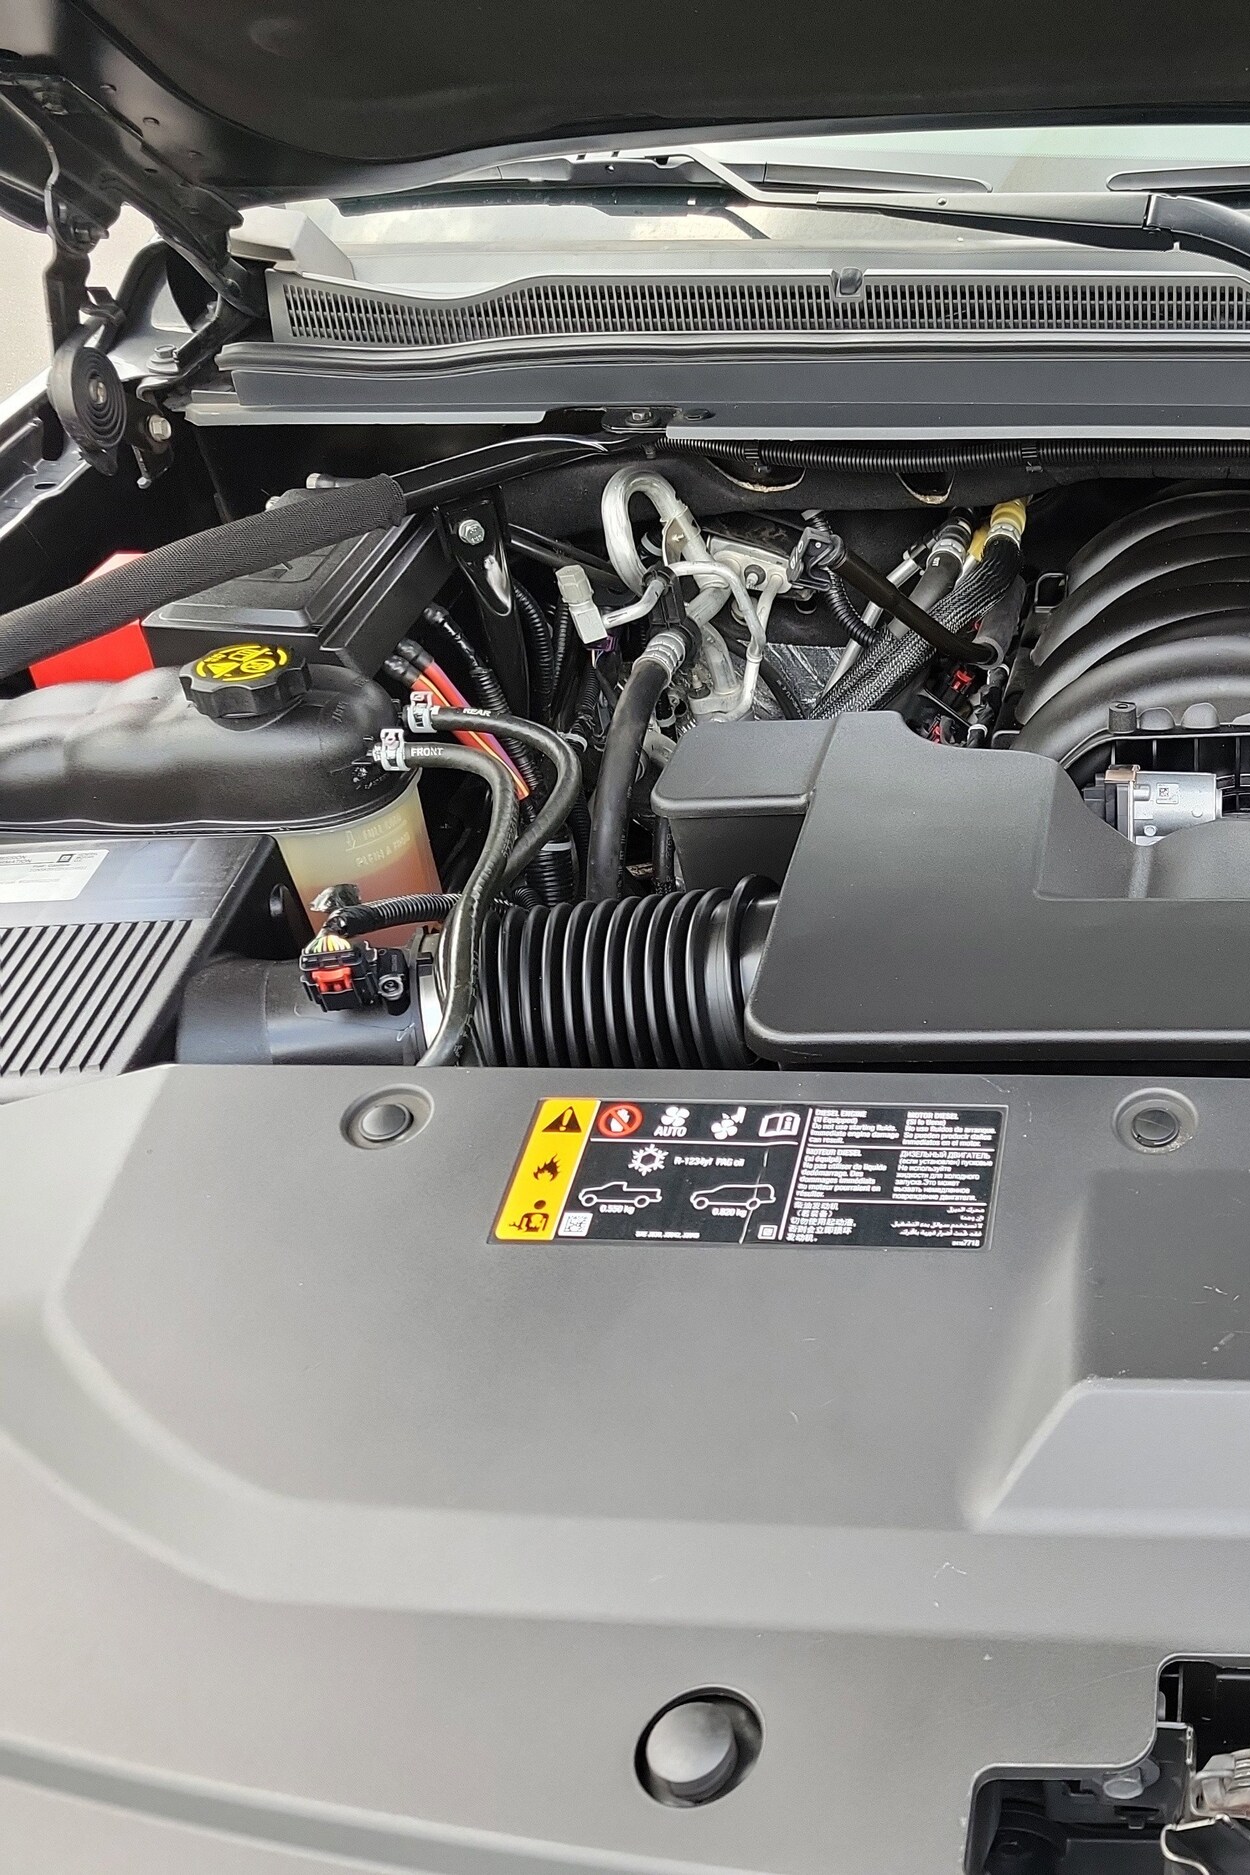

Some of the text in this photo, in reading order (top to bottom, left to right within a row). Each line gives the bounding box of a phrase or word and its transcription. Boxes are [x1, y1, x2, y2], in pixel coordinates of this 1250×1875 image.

[462, 708, 492, 717] REAR
[410, 747, 444, 757] FRONT
[654, 1126, 687, 1137] AUTO
